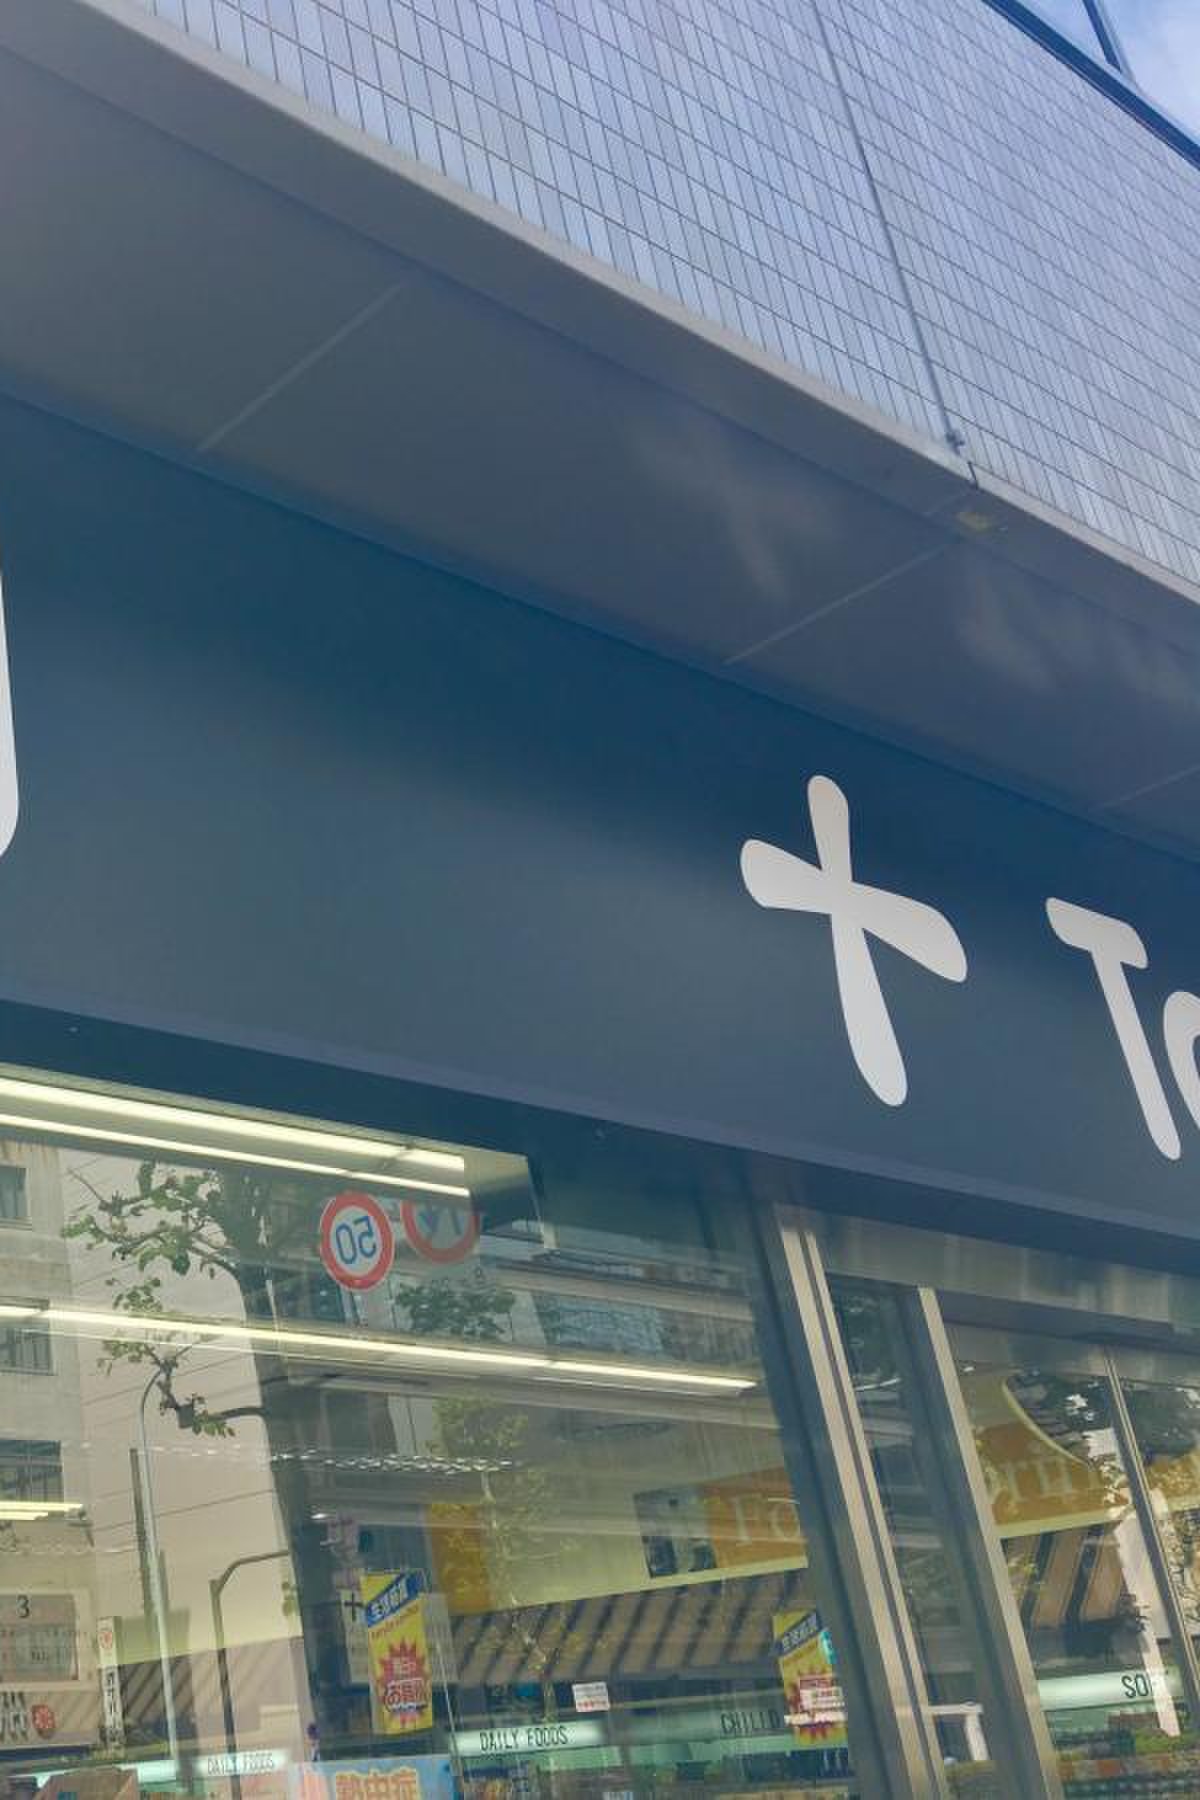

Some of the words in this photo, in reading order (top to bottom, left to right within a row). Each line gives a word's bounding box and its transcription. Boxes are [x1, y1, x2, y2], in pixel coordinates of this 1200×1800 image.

[17, 1595, 30, 1618] 3
[1121, 1673, 1153, 1698] SO
[480, 1728, 520, 1751] DAILY
[528, 1725, 569, 1747] FOODS
